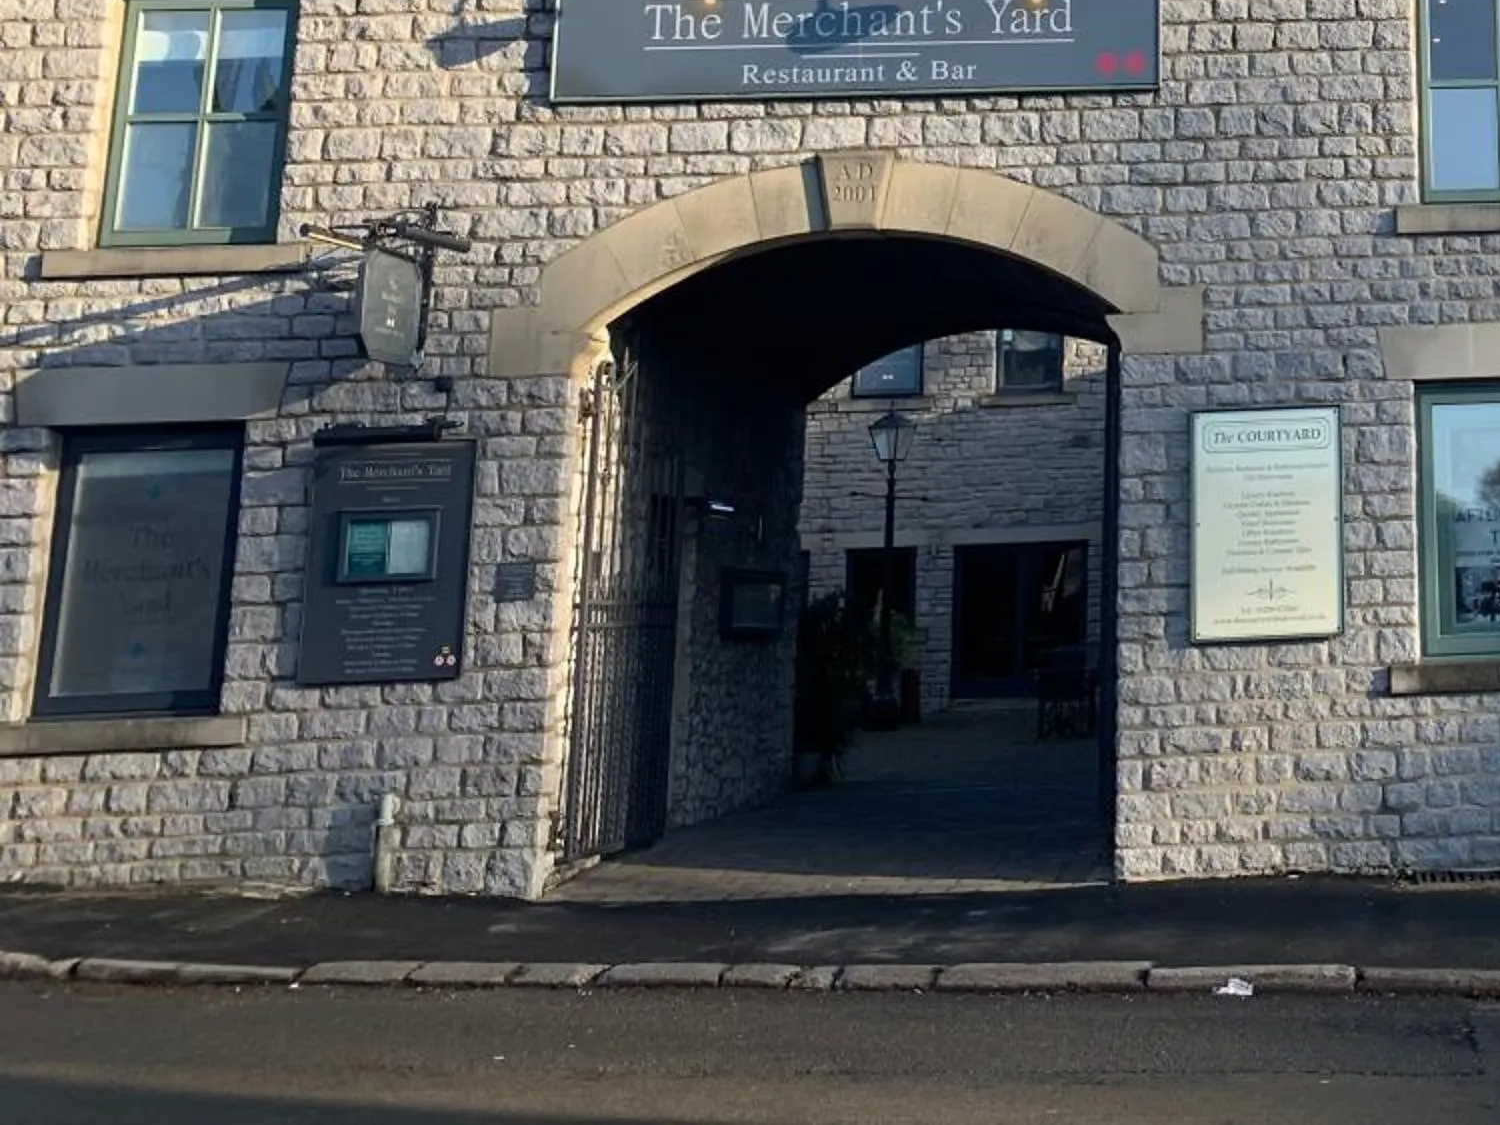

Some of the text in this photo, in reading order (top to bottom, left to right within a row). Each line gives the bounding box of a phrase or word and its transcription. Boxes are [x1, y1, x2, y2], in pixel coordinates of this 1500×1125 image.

[644, 3, 722, 40] The
[742, 0, 964, 39] Merchant's
[741, 60, 977, 85] Restaurant & Bar
[1237, 428, 1321, 442] COURTYARD
